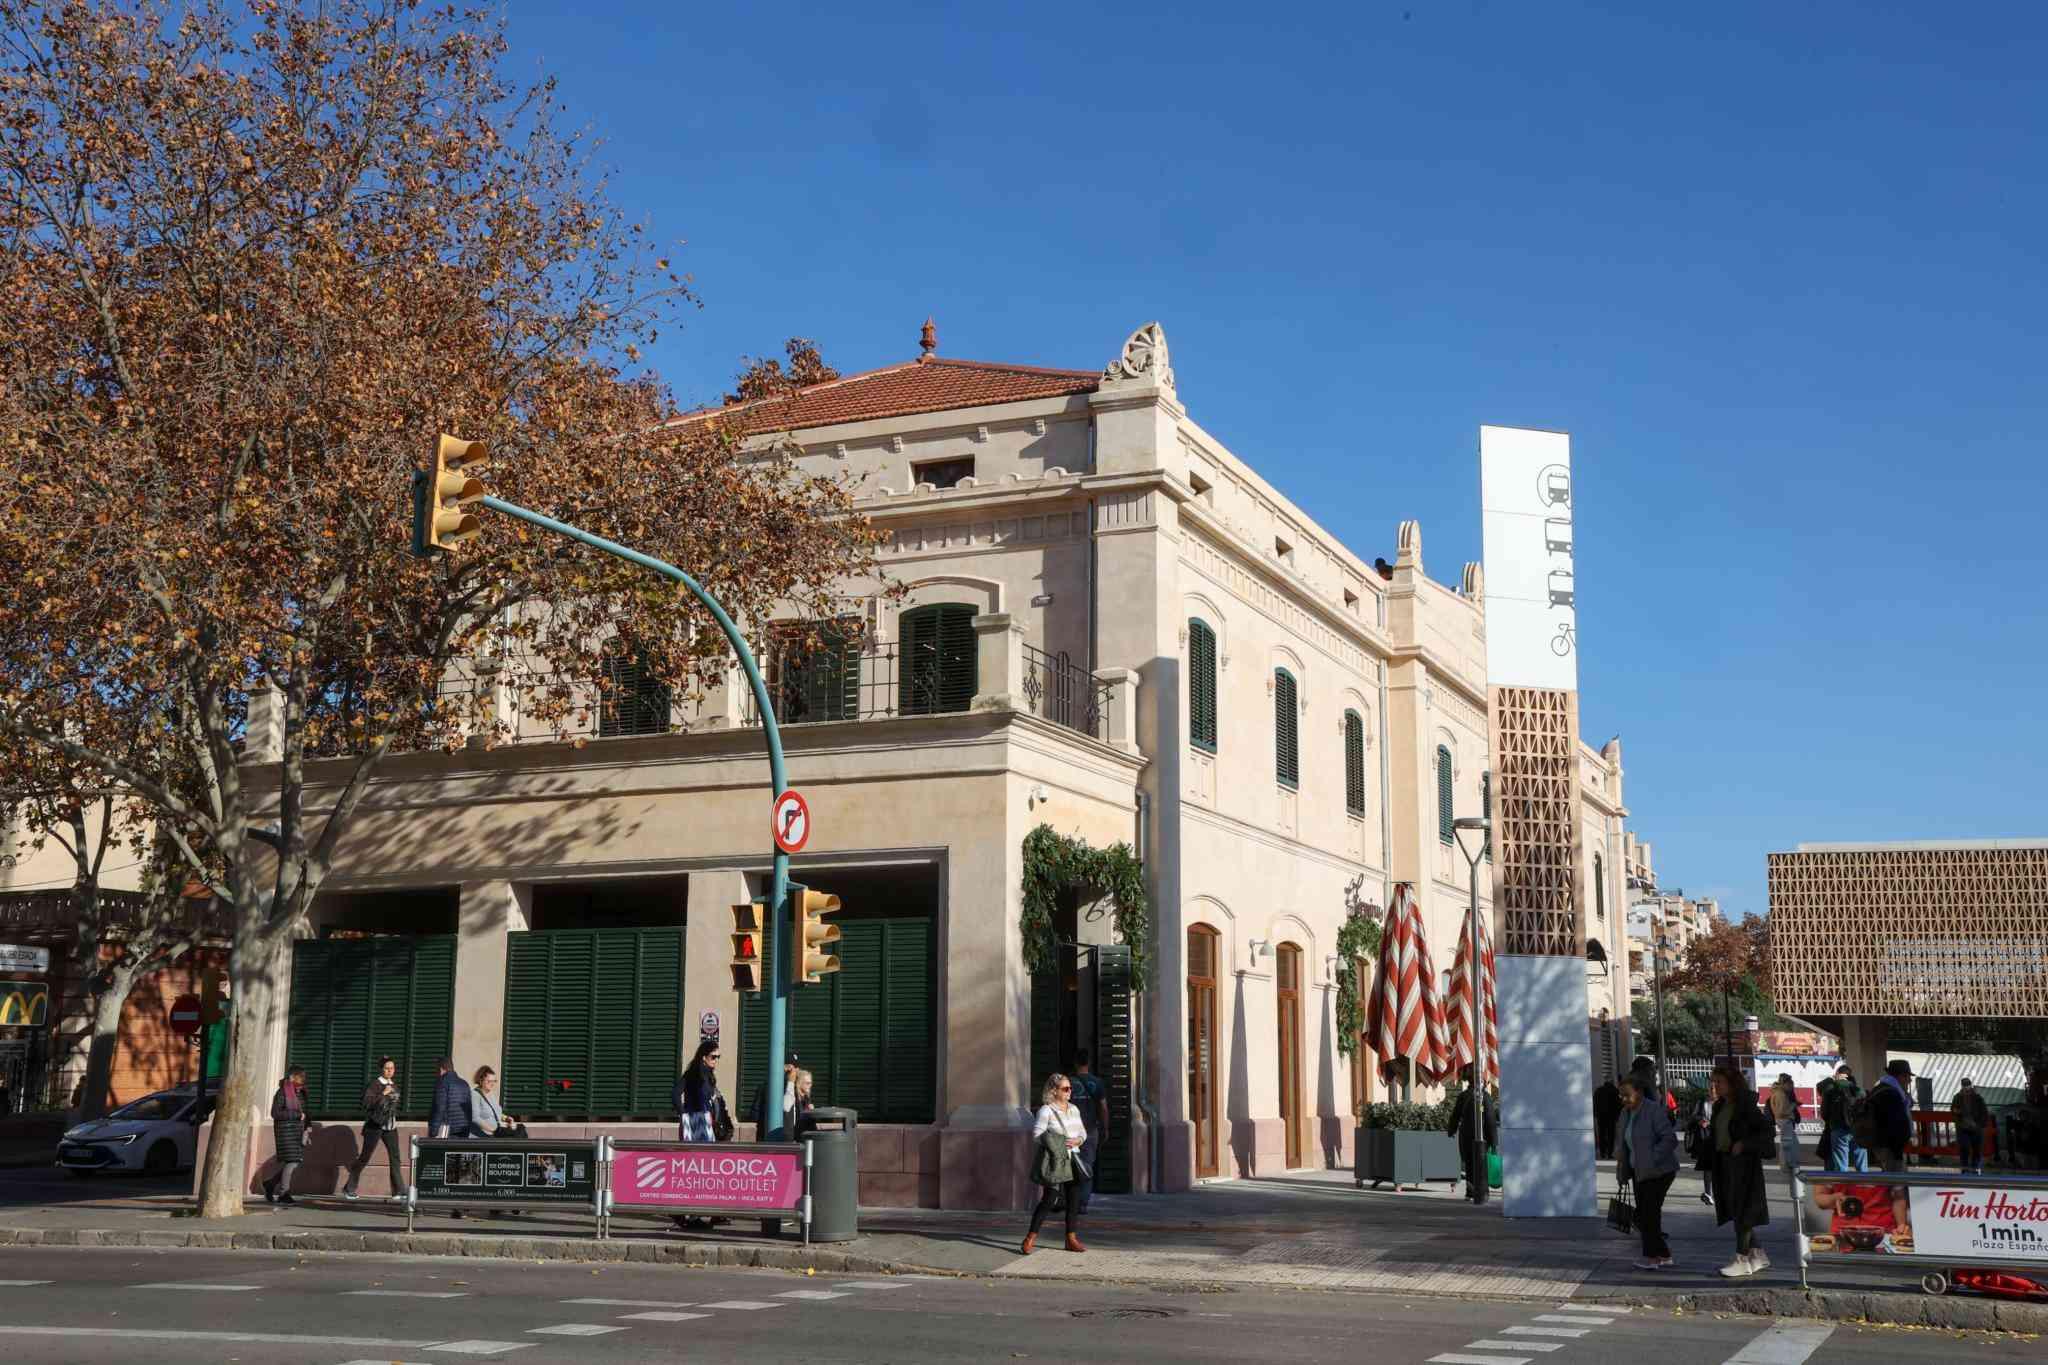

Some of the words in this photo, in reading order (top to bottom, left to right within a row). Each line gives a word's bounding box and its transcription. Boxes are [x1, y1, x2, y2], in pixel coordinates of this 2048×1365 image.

[671, 1158, 777, 1176] MALLORCA
[671, 1177, 724, 1190] FASHION
[729, 1179, 777, 1192] OUTLET
[1936, 1191, 1979, 1219] Tim
[1972, 1240, 2004, 1249] Plaza
